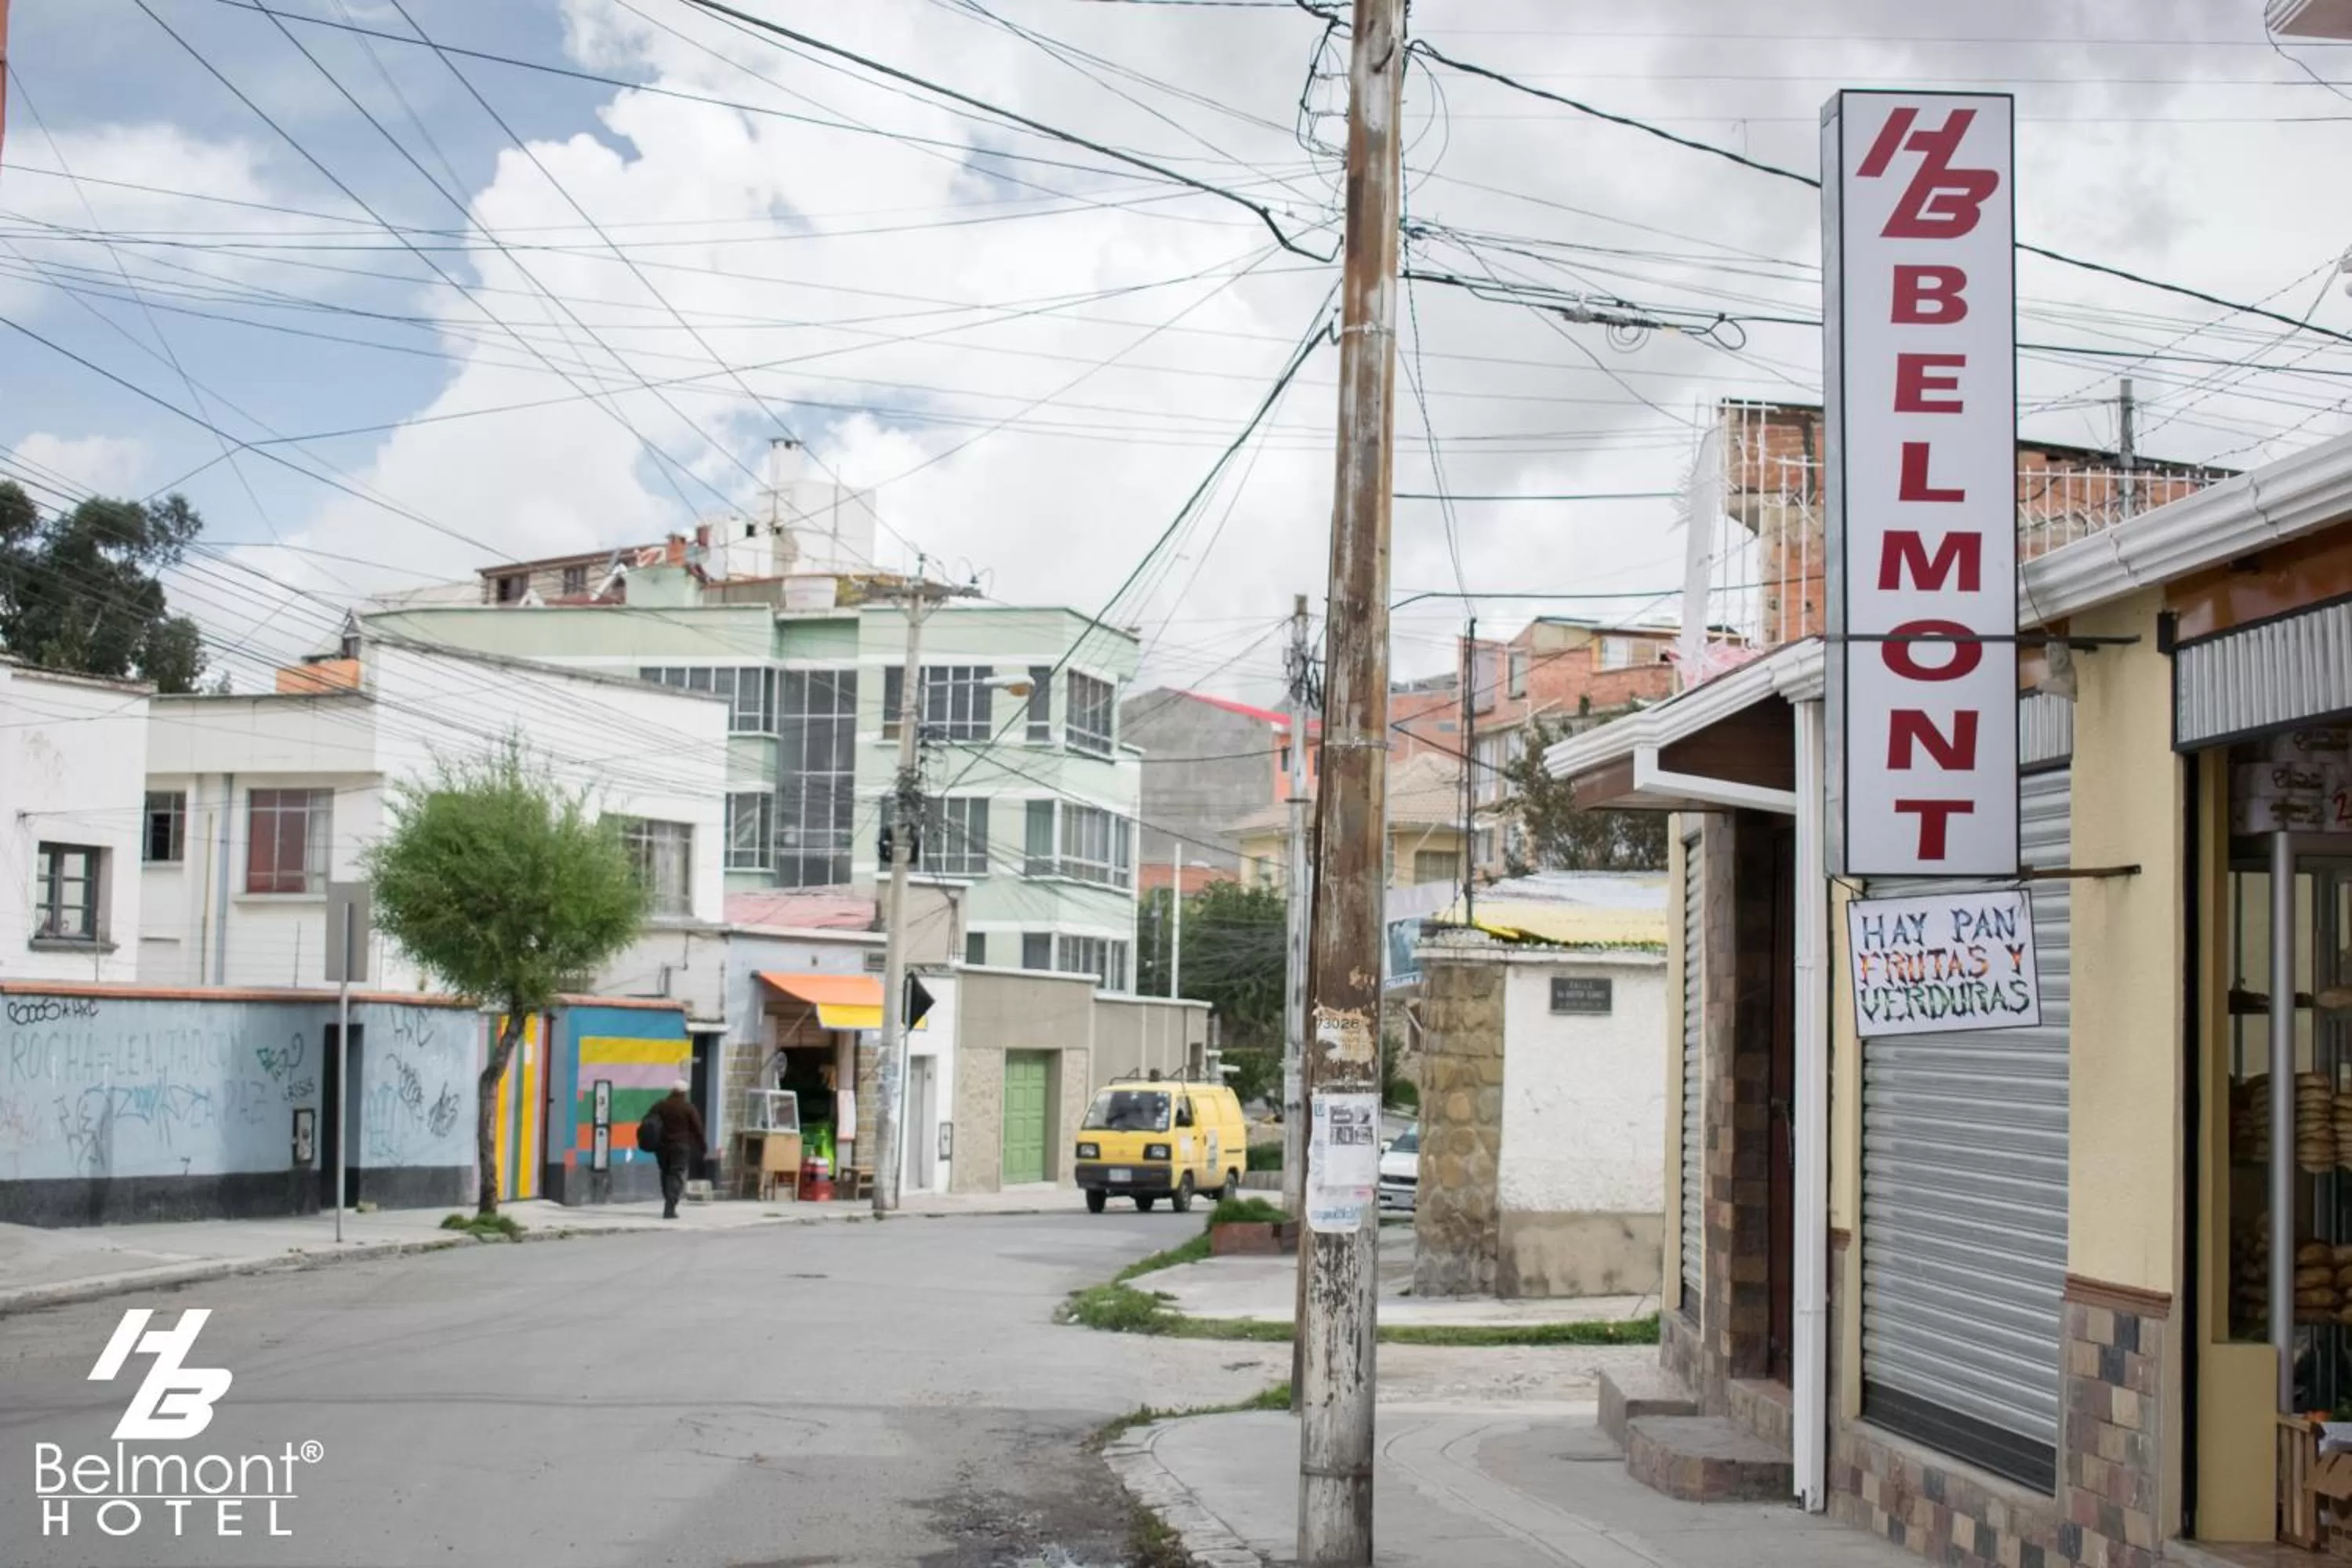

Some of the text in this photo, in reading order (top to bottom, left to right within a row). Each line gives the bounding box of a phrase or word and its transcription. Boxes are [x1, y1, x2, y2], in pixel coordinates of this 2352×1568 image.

[1878, 264, 1983, 861] BELMONT
[1860, 905, 2016, 950] HAY PAN
[1857, 942, 2026, 986] FRUTAS Y
[1859, 980, 2031, 1024] VERDURAS
